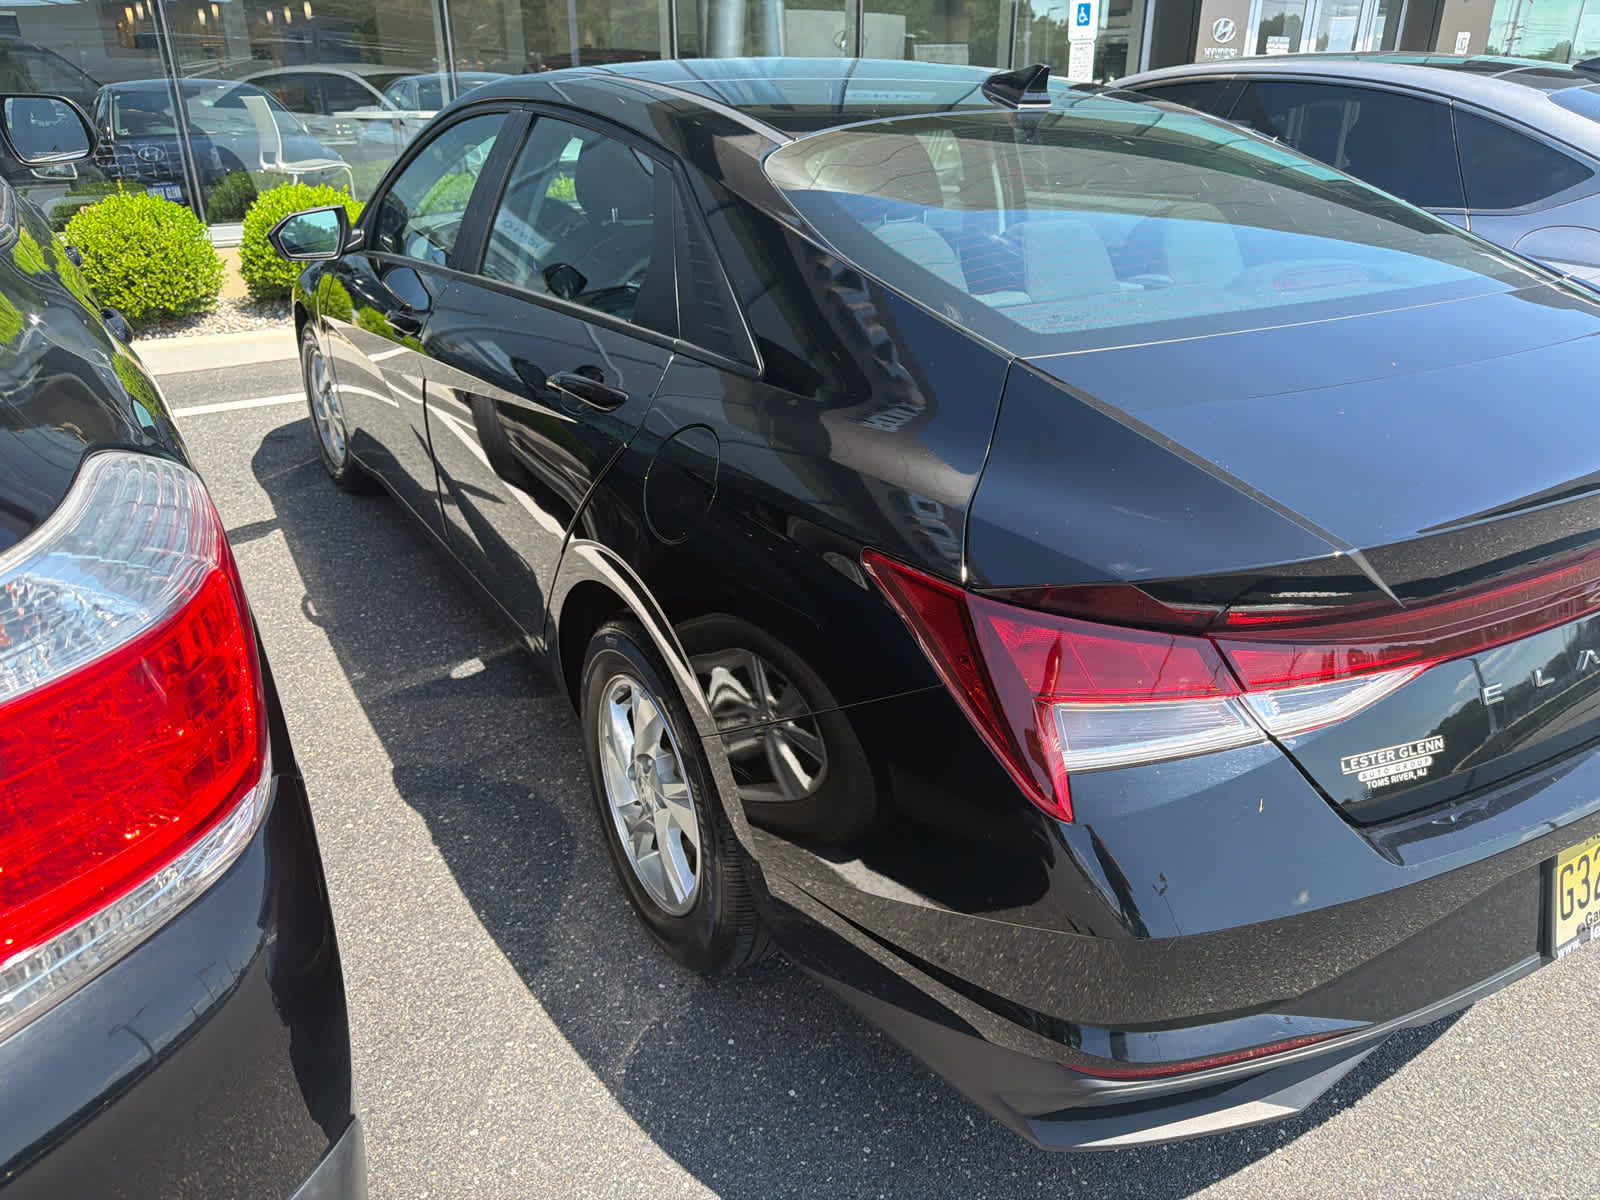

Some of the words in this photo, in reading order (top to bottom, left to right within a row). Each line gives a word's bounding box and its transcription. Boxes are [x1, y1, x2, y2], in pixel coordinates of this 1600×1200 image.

[1341, 749, 1396, 772] LESTER
[1399, 738, 1445, 758] GLENN
[1361, 767, 1390, 781] AUTO
[1395, 757, 1430, 772] GROUP
[1366, 777, 1390, 790] TOMS
[1391, 770, 1417, 784] RIVER,
[1417, 767, 1427, 777] NJ
